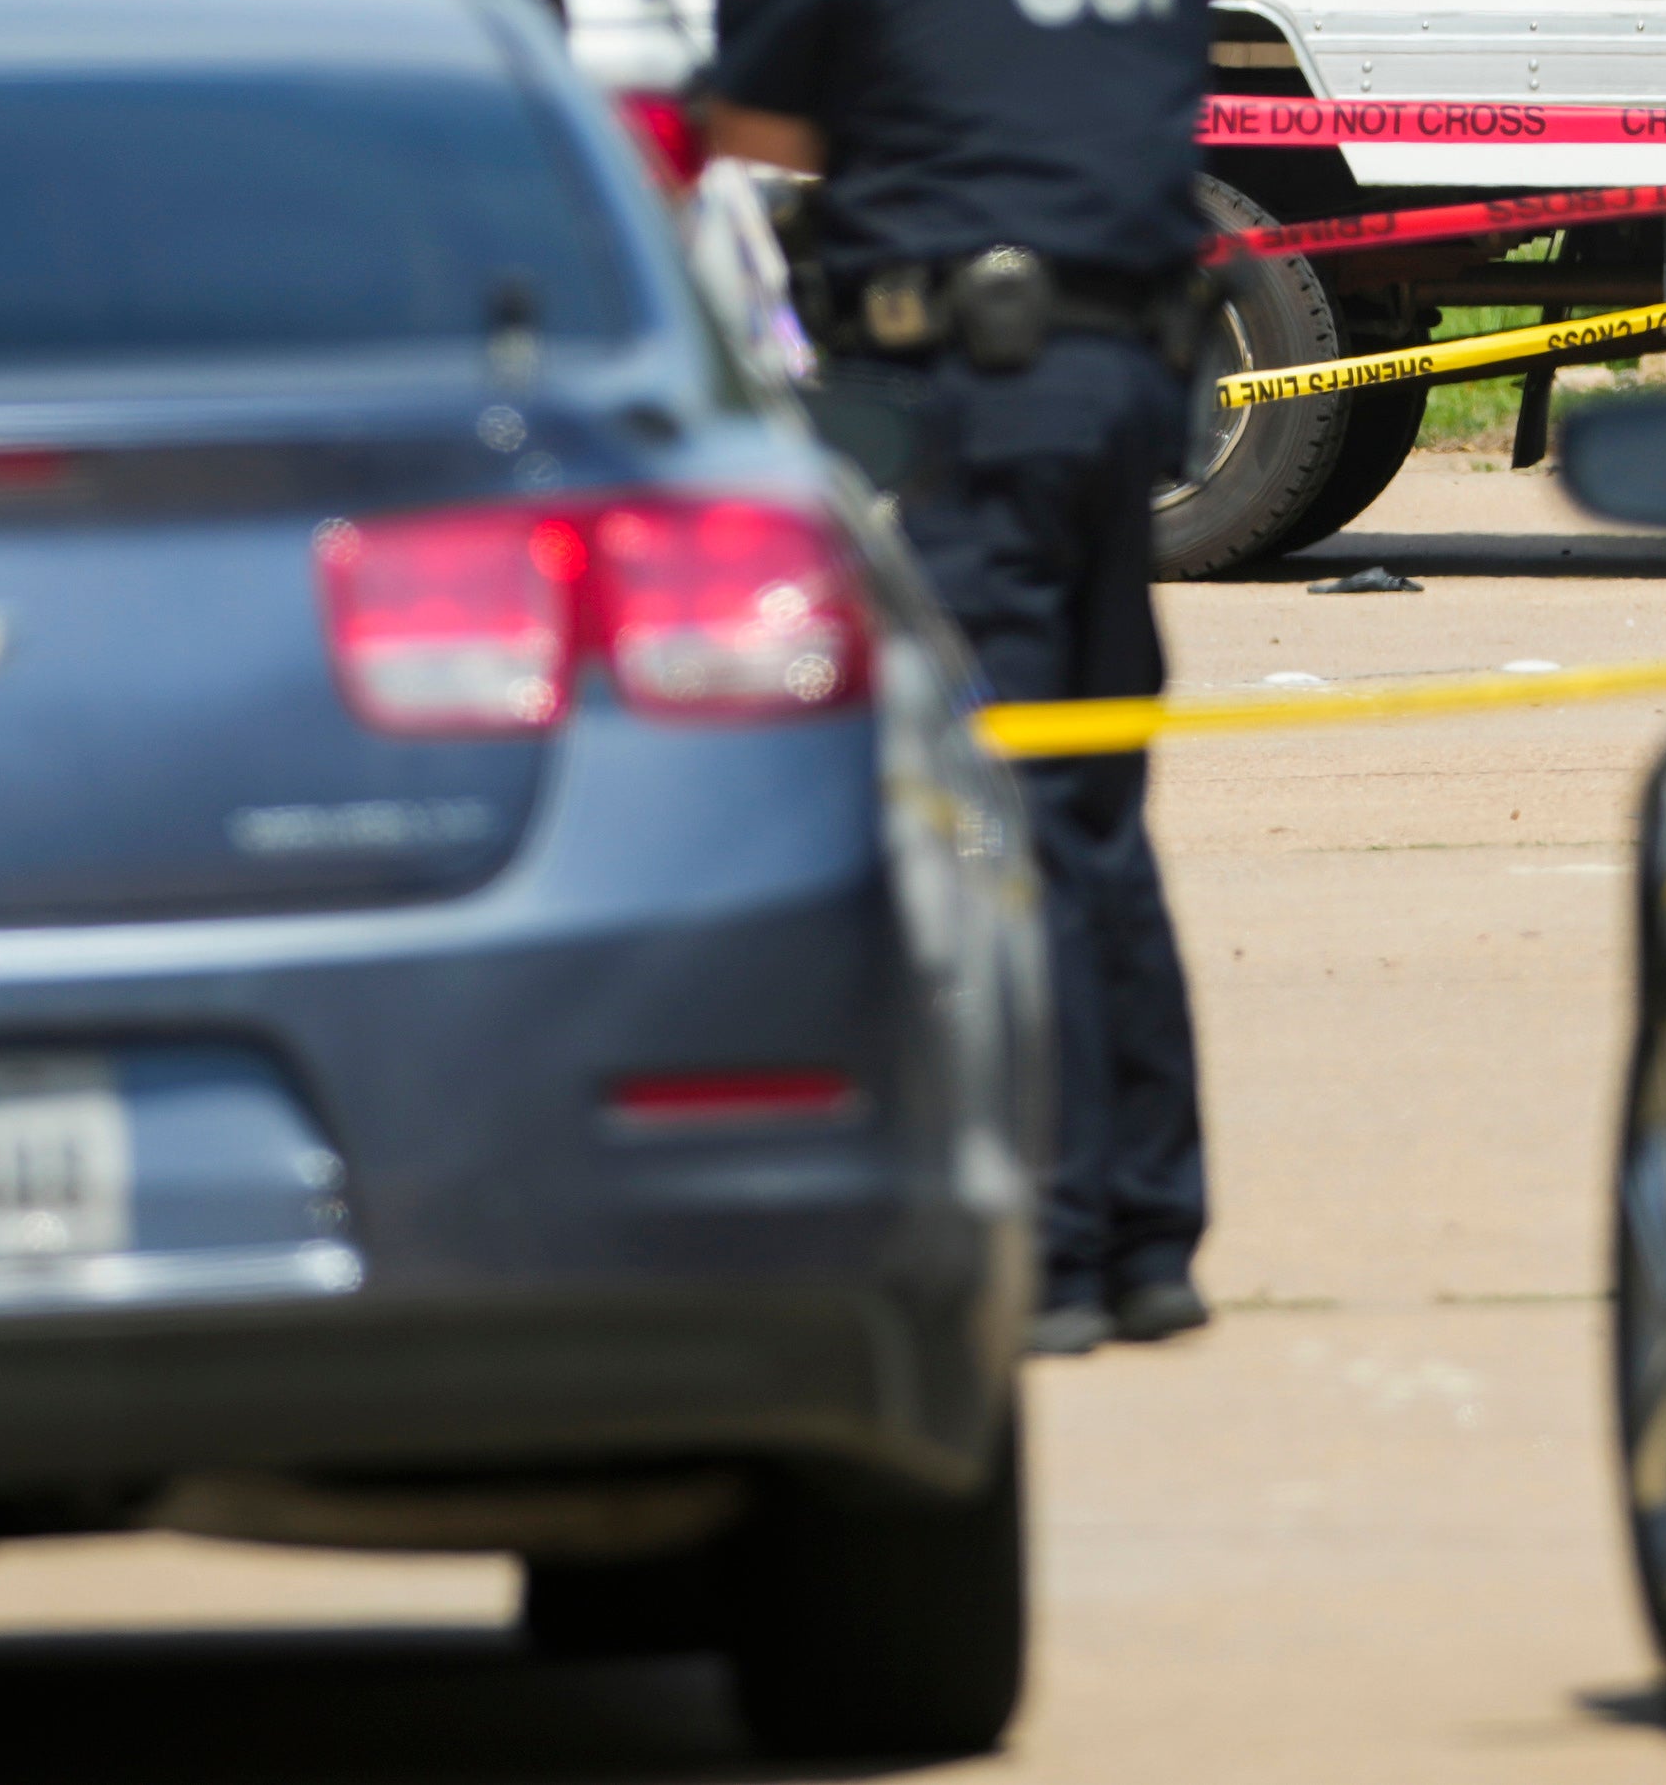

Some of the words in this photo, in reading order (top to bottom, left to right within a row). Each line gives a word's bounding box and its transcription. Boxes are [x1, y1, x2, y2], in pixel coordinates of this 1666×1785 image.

[1270, 104, 1323, 136] DO
[1333, 103, 1406, 136] NOT
[1418, 103, 1548, 137] CROSS
[1240, 374, 1300, 404] LINE
